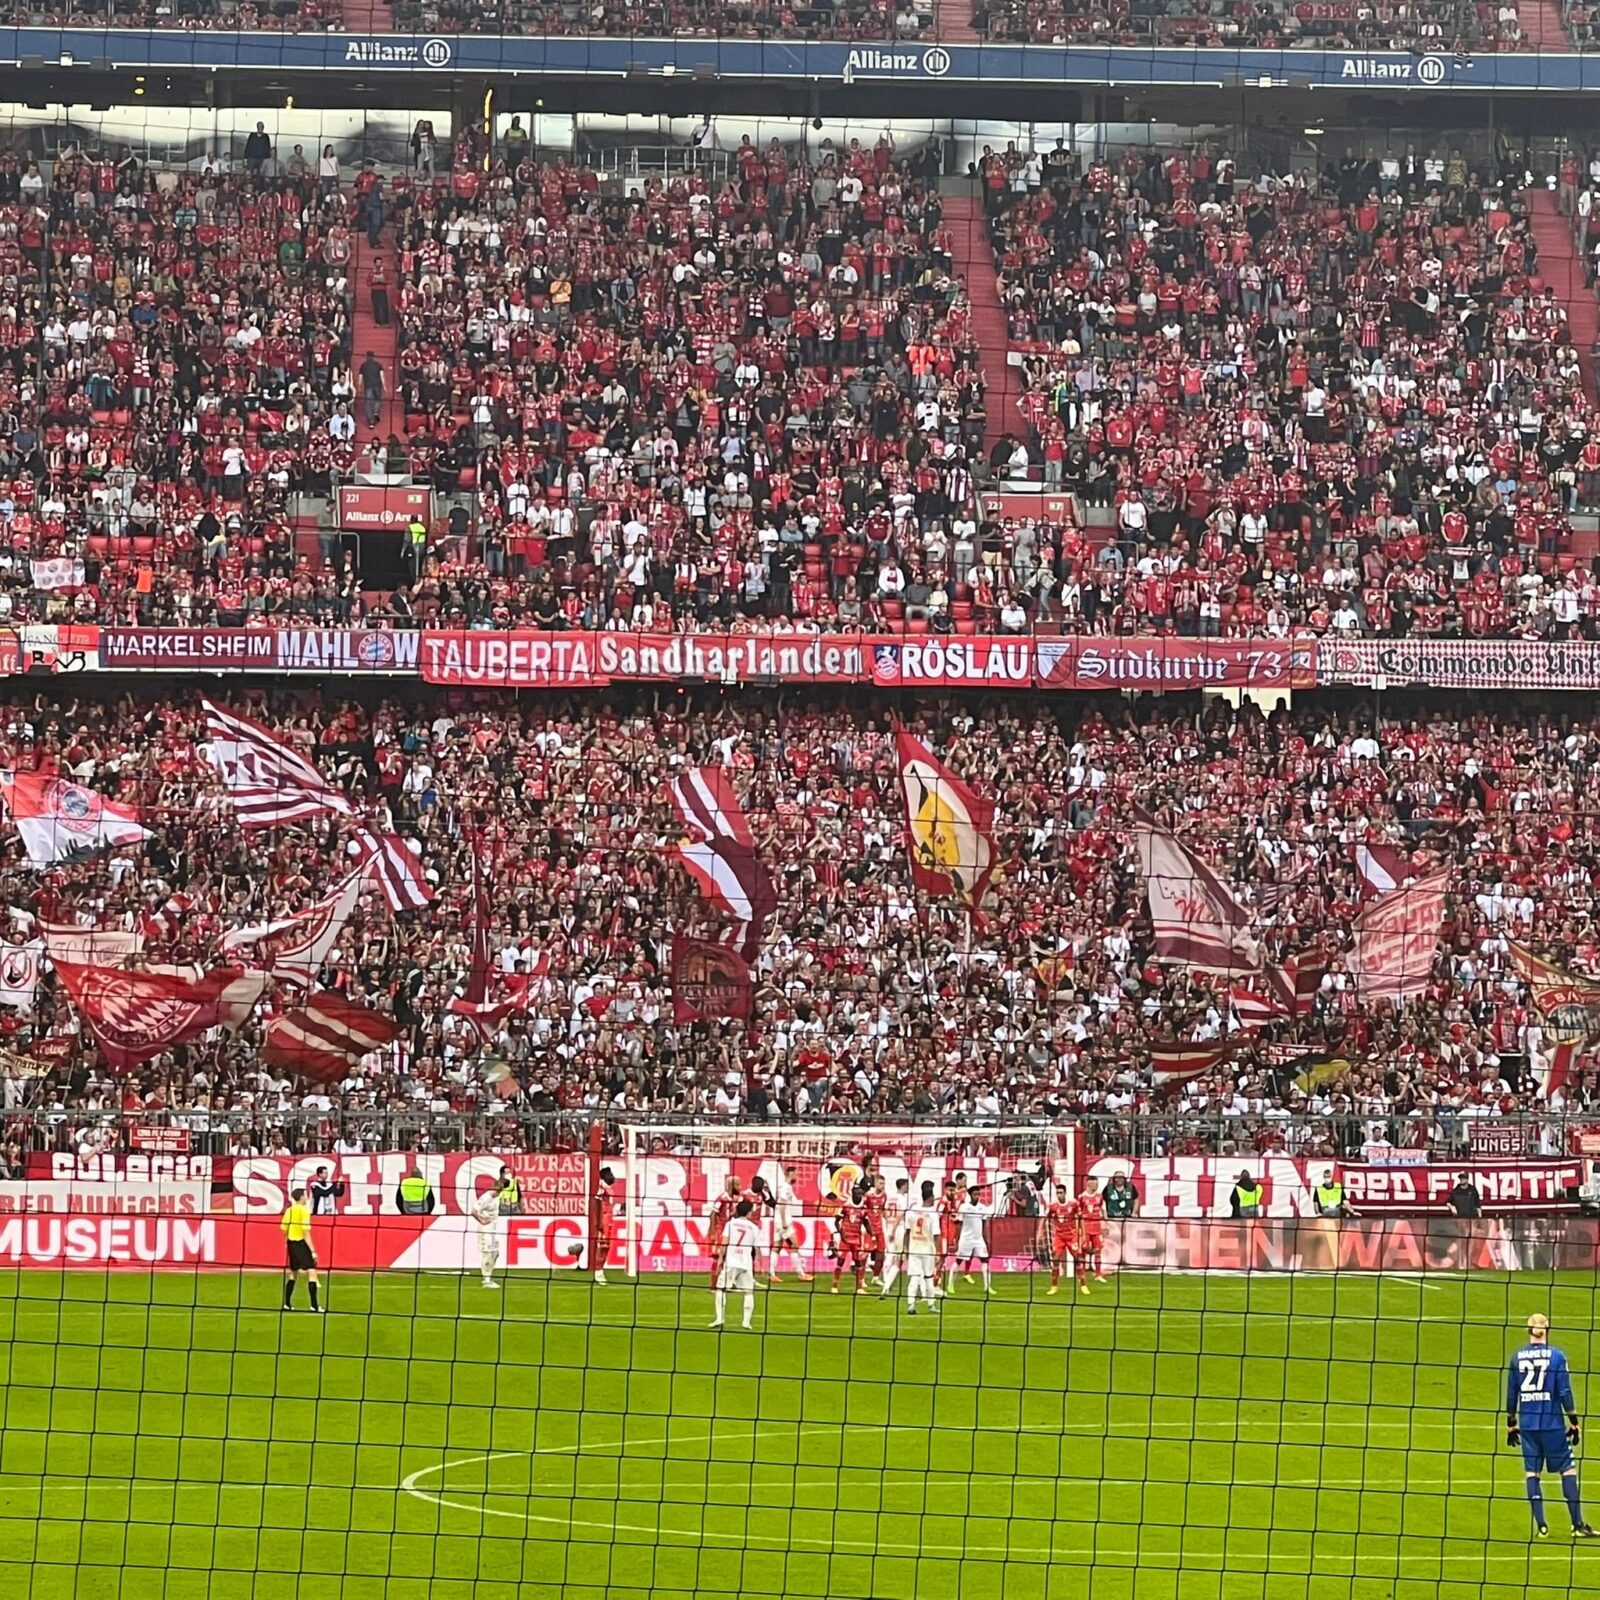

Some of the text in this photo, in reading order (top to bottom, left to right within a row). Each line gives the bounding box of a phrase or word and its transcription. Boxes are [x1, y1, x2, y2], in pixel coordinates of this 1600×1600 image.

[345, 42, 418, 61] Allianz
[848, 50, 918, 70] Allianz
[1341, 59, 1412, 78] Allianz
[345, 494, 360, 503] 221
[345, 511, 379, 522] Allianz
[107, 635, 272, 657] MARKELSHEIM
[600, 636, 863, 676] Sandharlanden
[902, 640, 1029, 679] RÖSLAU
[1077, 648, 1228, 680] Südkurve
[1380, 648, 1534, 675] Commando
[764, 1139, 791, 1154] BEI
[797, 1140, 830, 1156] UNS
[1470, 1138, 1525, 1152] JUNGS!
[507, 1219, 582, 1266] FC
[1519, 1359, 1550, 1391] 27
